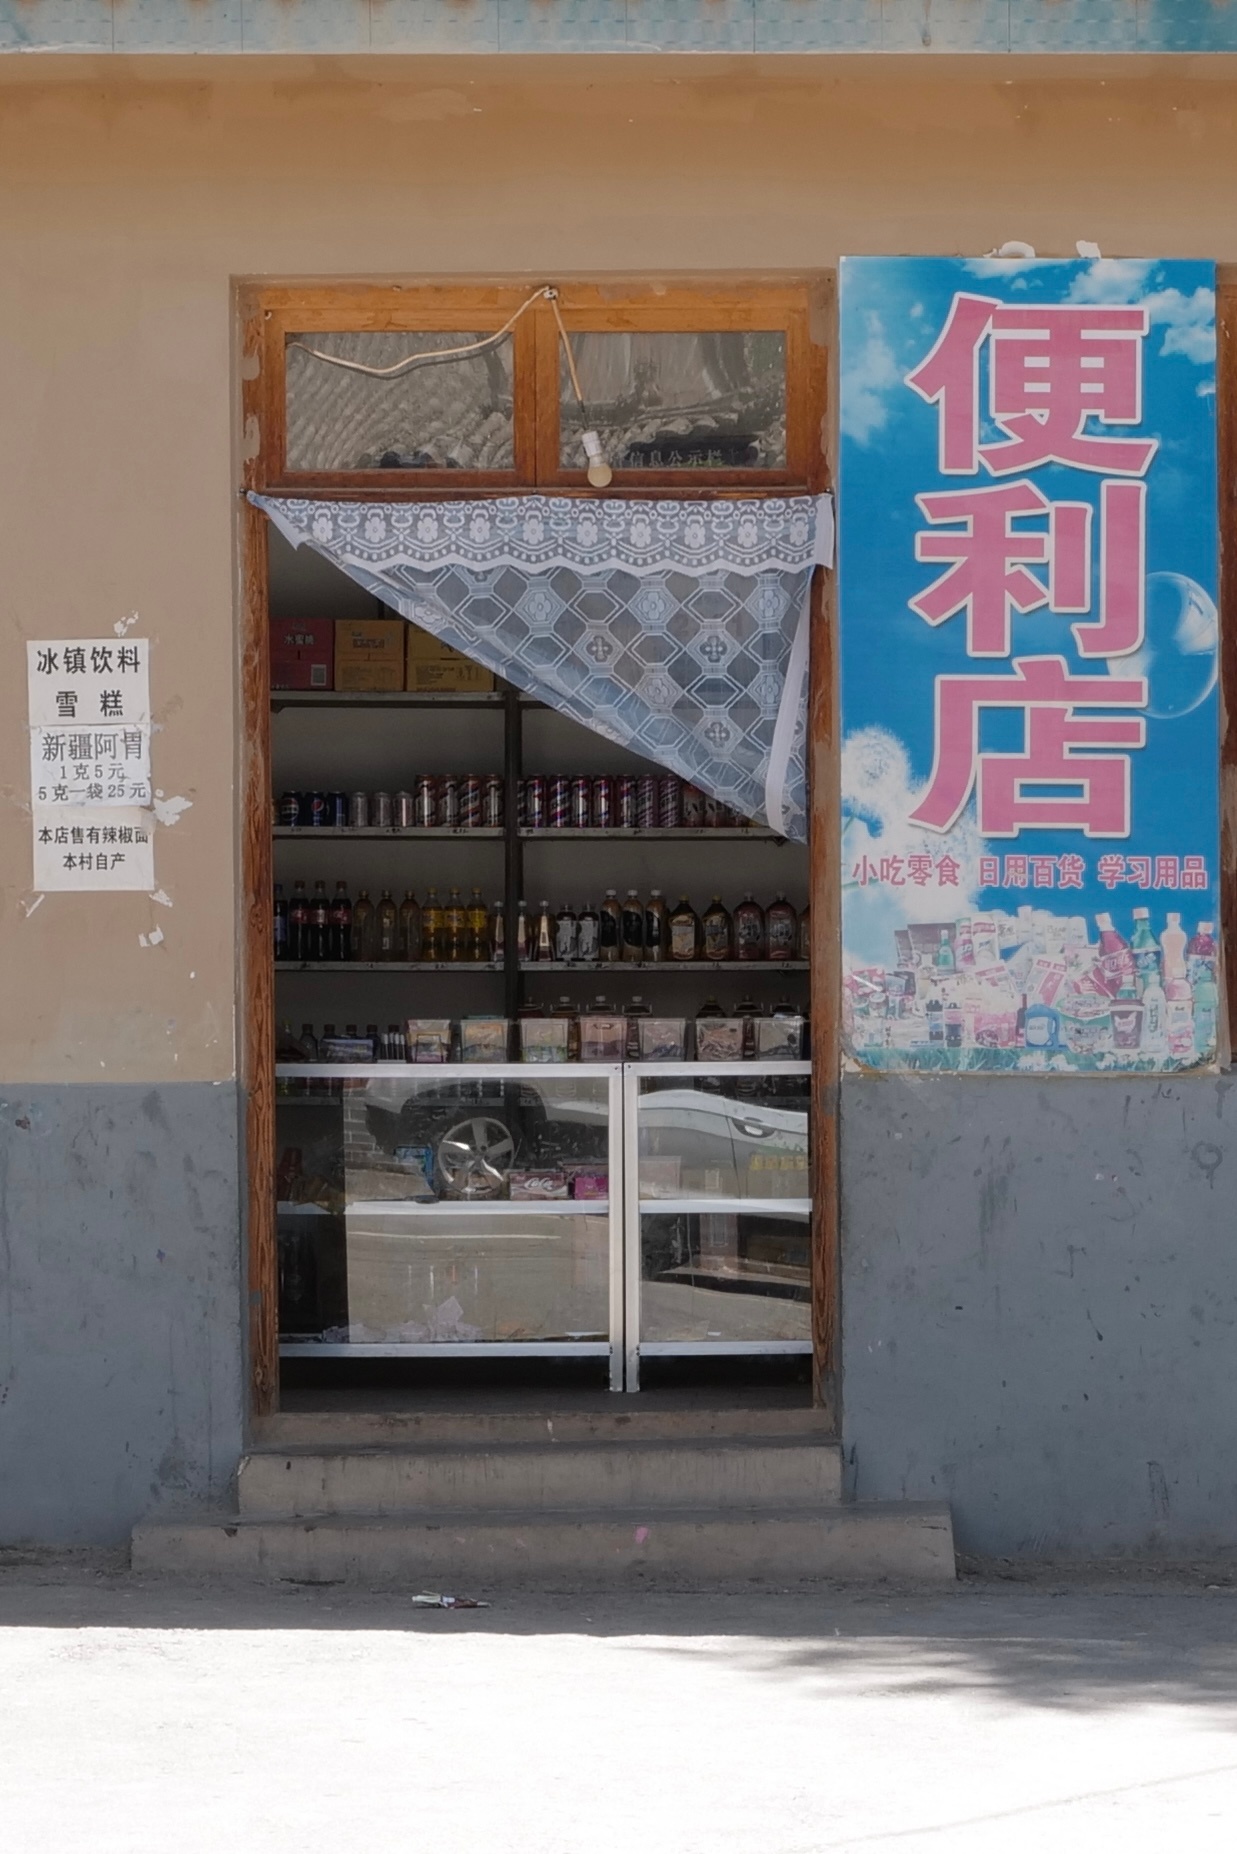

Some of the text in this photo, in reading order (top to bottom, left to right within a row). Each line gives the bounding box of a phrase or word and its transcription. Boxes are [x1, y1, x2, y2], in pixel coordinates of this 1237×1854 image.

[904, 292, 1159, 837] 便利店
[37, 646, 141, 674] 冰镇饮料
[63, 852, 125, 870] 本村自产
[852, 853, 1208, 889] 小吃零食 日用百货 学习用品
